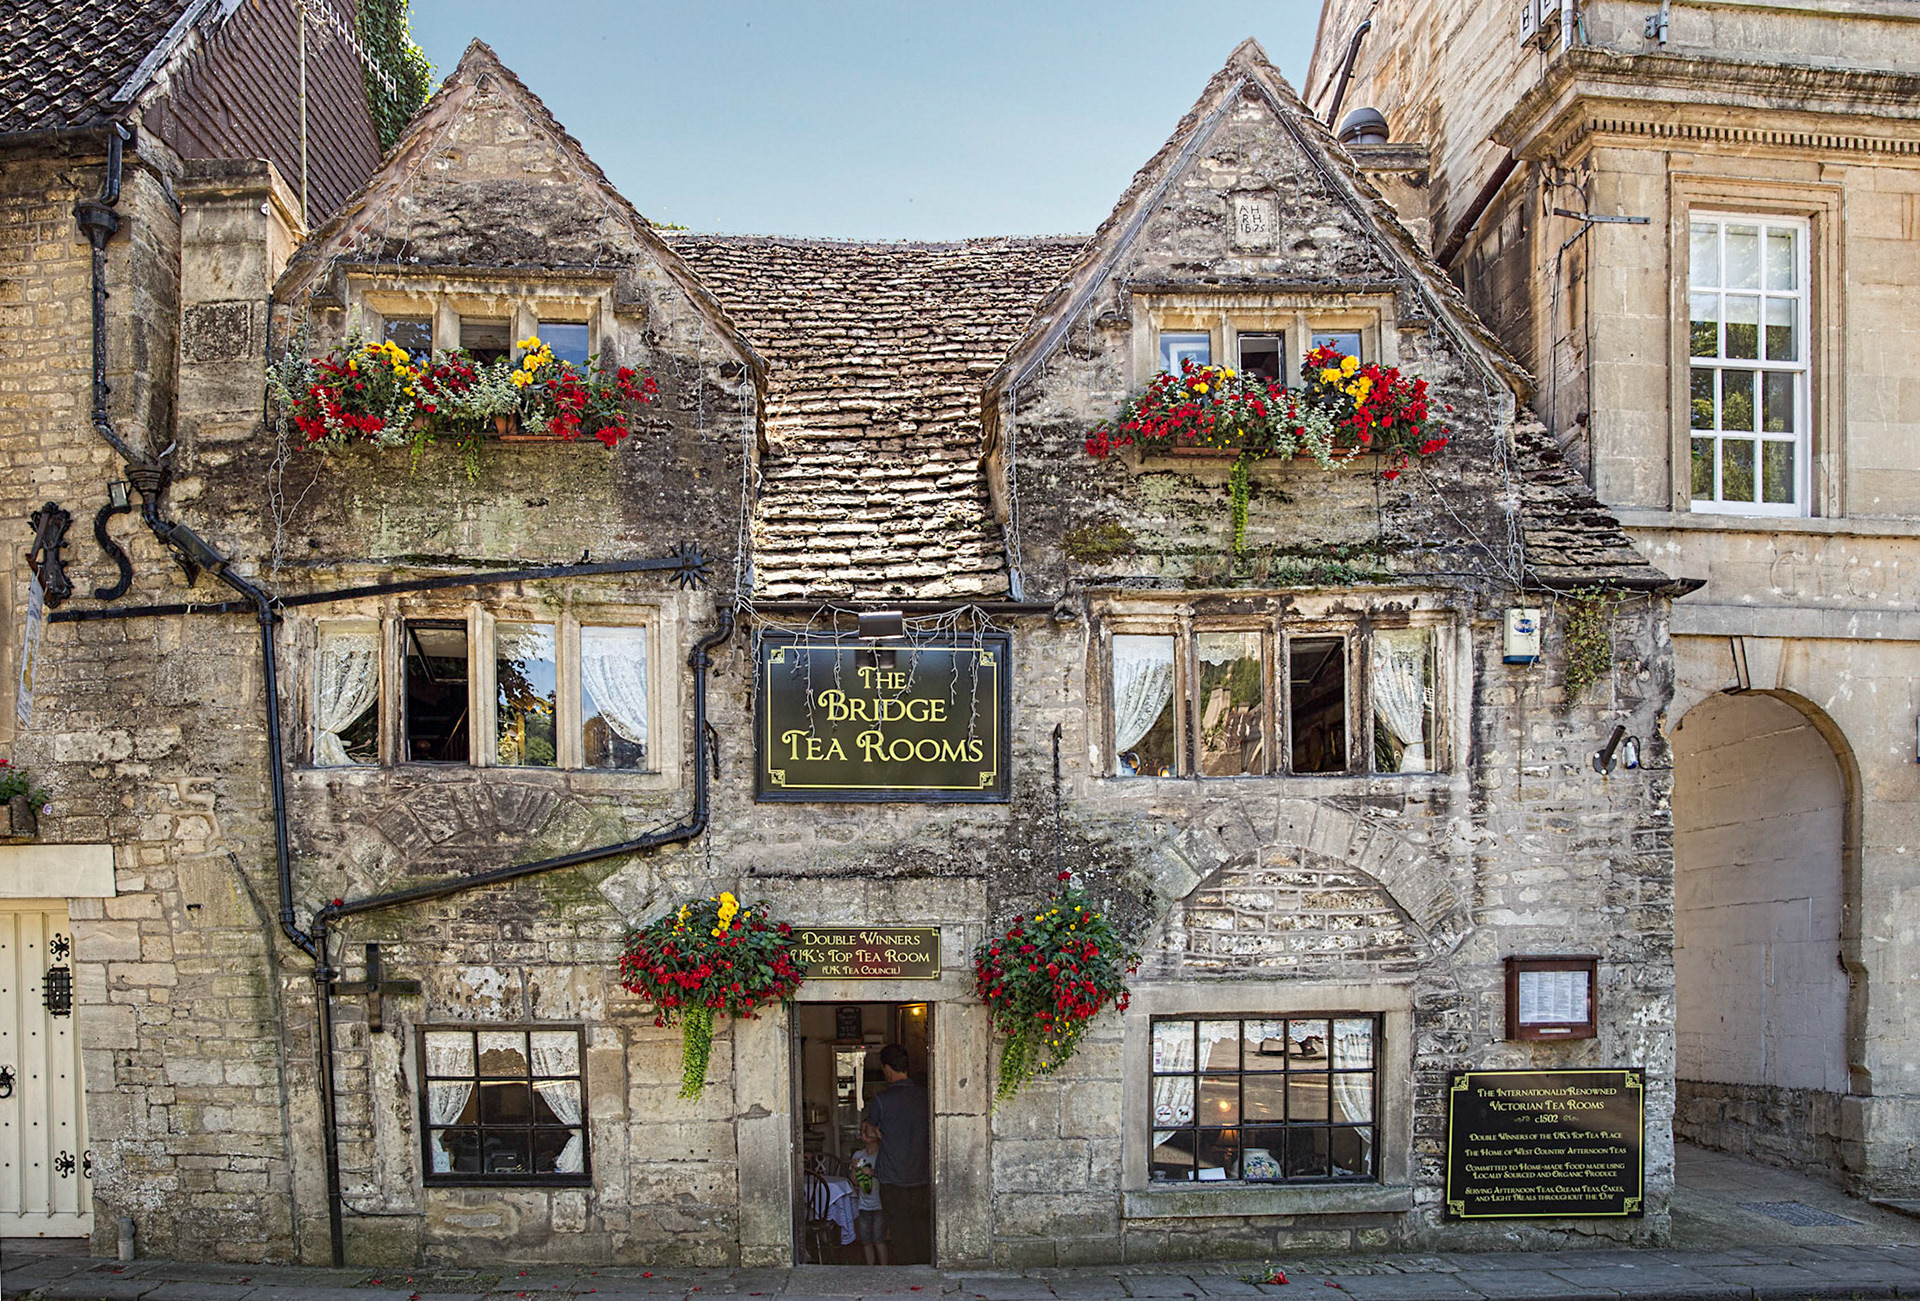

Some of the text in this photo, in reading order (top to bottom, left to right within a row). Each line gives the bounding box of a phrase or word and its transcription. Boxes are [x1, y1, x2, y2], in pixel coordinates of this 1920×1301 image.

[857, 666, 907, 690] THE
[818, 689, 948, 722] BRIDGE
[781, 730, 984, 763] TEA ROOMS
[801, 931, 921, 946] DOUBLE WINNERS
[827, 949, 853, 964] TOP
[855, 949, 882, 963] TEA
[884, 949, 930, 963] ROOM
[842, 966, 860, 975] TEA
[1477, 1086, 1617, 1098] THE INTERNATIONALLY RENOWNED
[1489, 1099, 1605, 1111] VICTORIAN TEA ROOMS
[1469, 1133, 1497, 1142] DOUBLE
[1498, 1132, 1528, 1141] WINNERS
[1571, 1131, 1584, 1140] TOP
[1585, 1131, 1600, 1139] TEA
[1600, 1131, 1622, 1139] PLACE
[1464, 1149, 1479, 1157] THE
[1480, 1148, 1503, 1157] HOME
[1513, 1147, 1533, 1156] WEST
[1533, 1147, 1566, 1155] COUNTRY
[1567, 1146, 1609, 1155] AFTERNOON
[1609, 1146, 1627, 1154] TEAS
[1465, 1164, 1508, 1172] COMMITTED
[1564, 1162, 1586, 1170] FOOD
[1472, 1171, 1503, 1180] LOCALLY
[1503, 1171, 1536, 1179] SOURCED
[1584, 1169, 1617, 1177] PRODUCE
[1465, 1187, 1493, 1195] SERVING
[1493, 1186, 1536, 1195] AFTERNOON
[1555, 1185, 1581, 1193] CREAM
[1490, 1194, 1512, 1202] LIGHT
[1598, 1192, 1615, 1200] DAY
